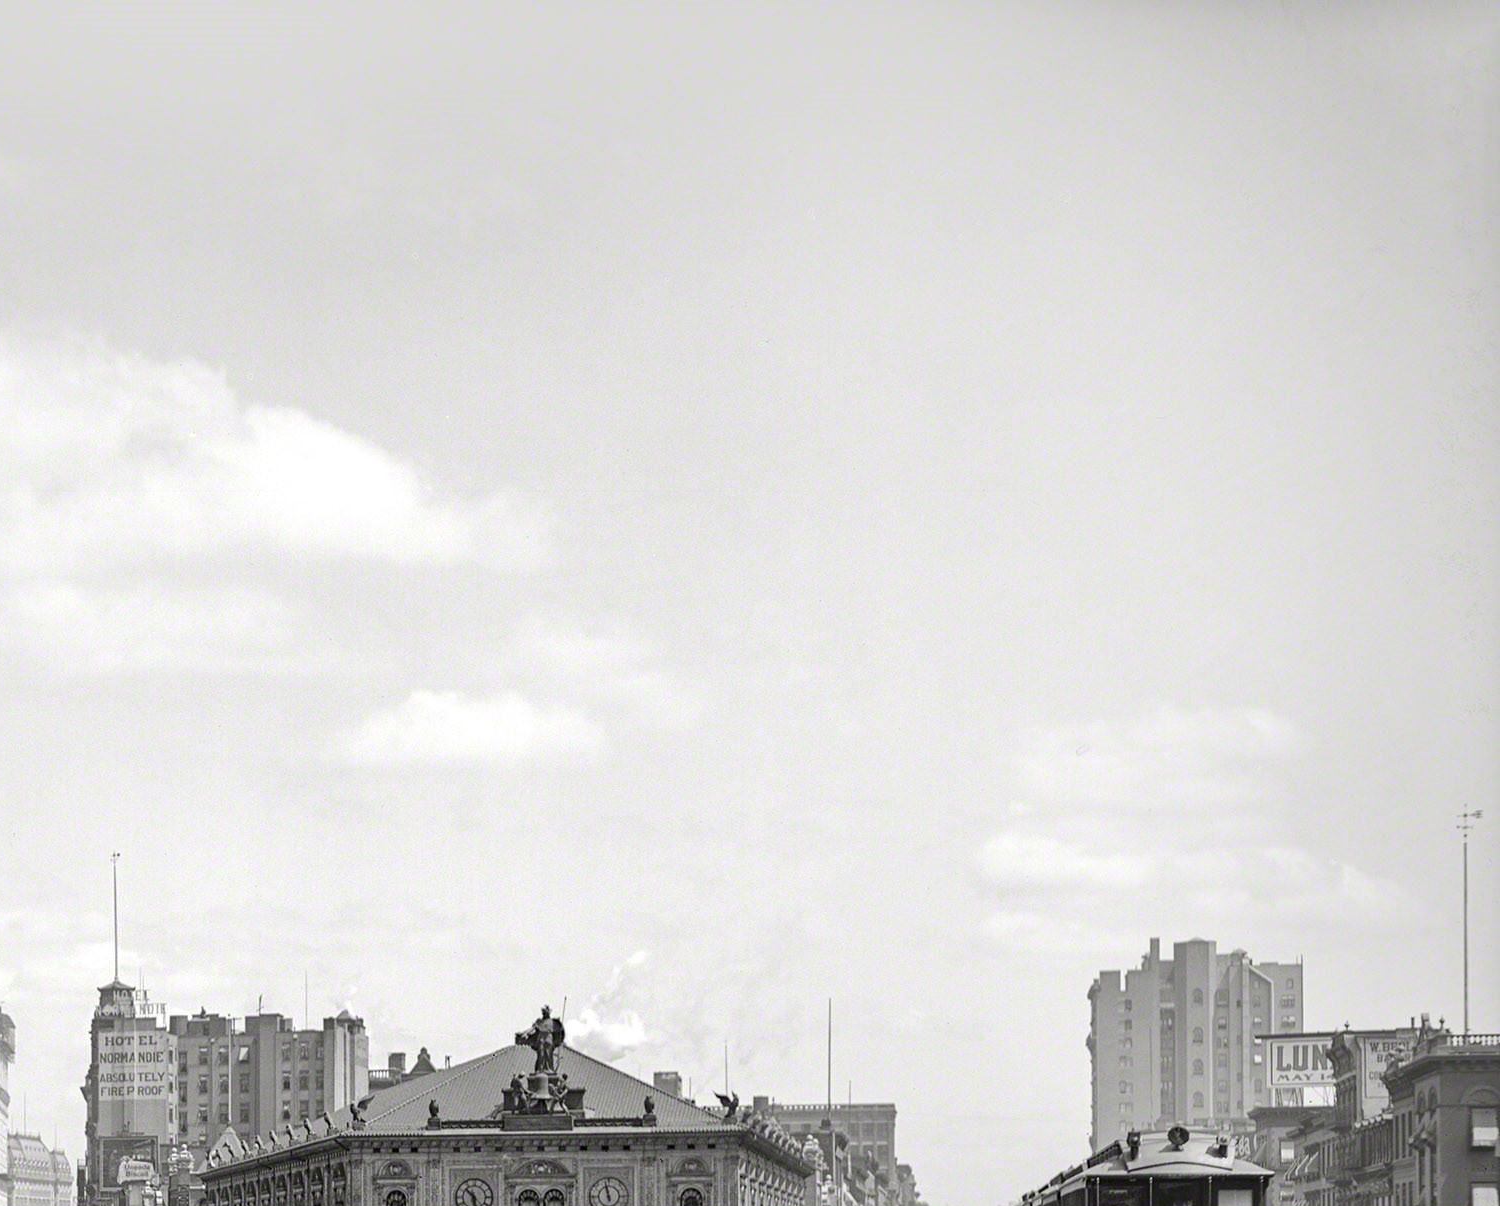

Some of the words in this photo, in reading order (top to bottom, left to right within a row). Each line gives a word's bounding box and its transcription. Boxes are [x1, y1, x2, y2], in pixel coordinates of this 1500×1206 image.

[104, 1036, 157, 1046] HOTEL
[100, 1052, 164, 1063] NORMANDIE
[1276, 1044, 1335, 1071] LUN
[100, 1072, 165, 1083] ABSOLUTELY
[1277, 1074, 1313, 1082] MAY
